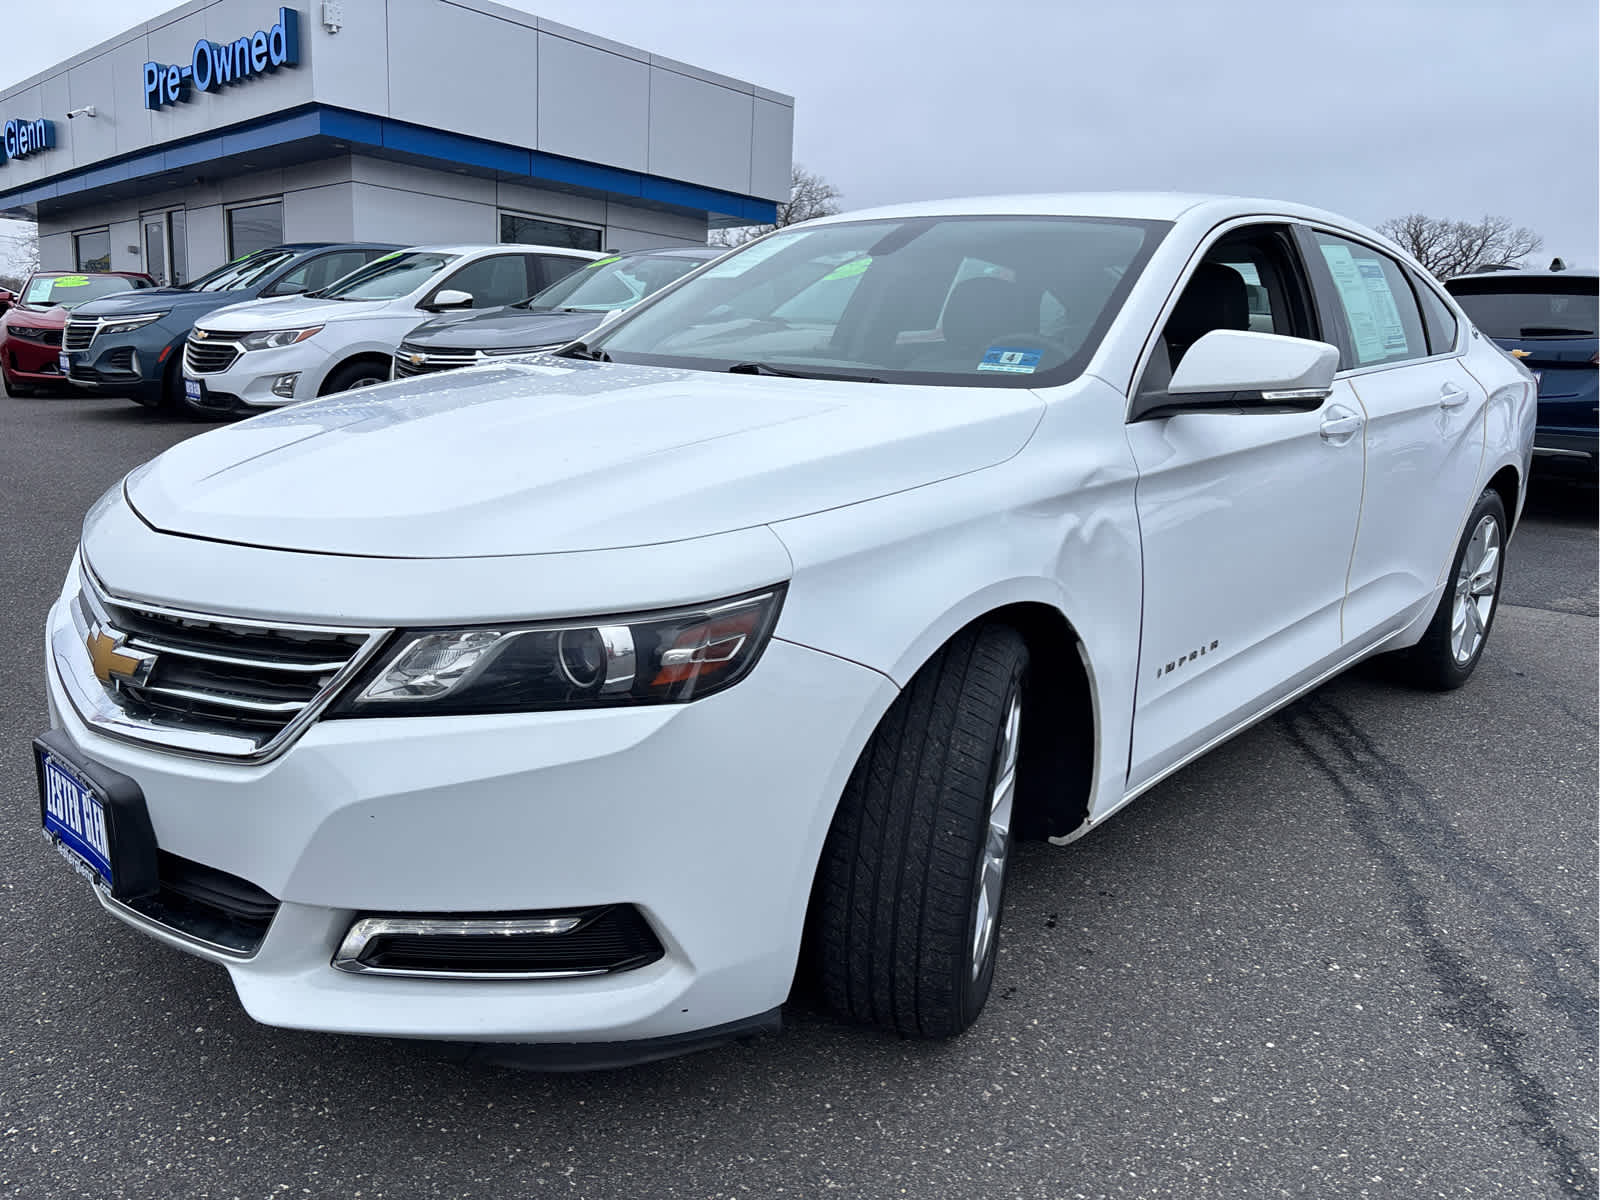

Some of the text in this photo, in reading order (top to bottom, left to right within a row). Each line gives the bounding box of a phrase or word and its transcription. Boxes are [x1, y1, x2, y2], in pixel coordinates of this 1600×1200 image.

[144, 7, 289, 109] Pre-Owned
[4, 119, 48, 159] Glenn
[1157, 640, 1219, 679] IMPALA
[45, 764, 82, 836] LESTER
